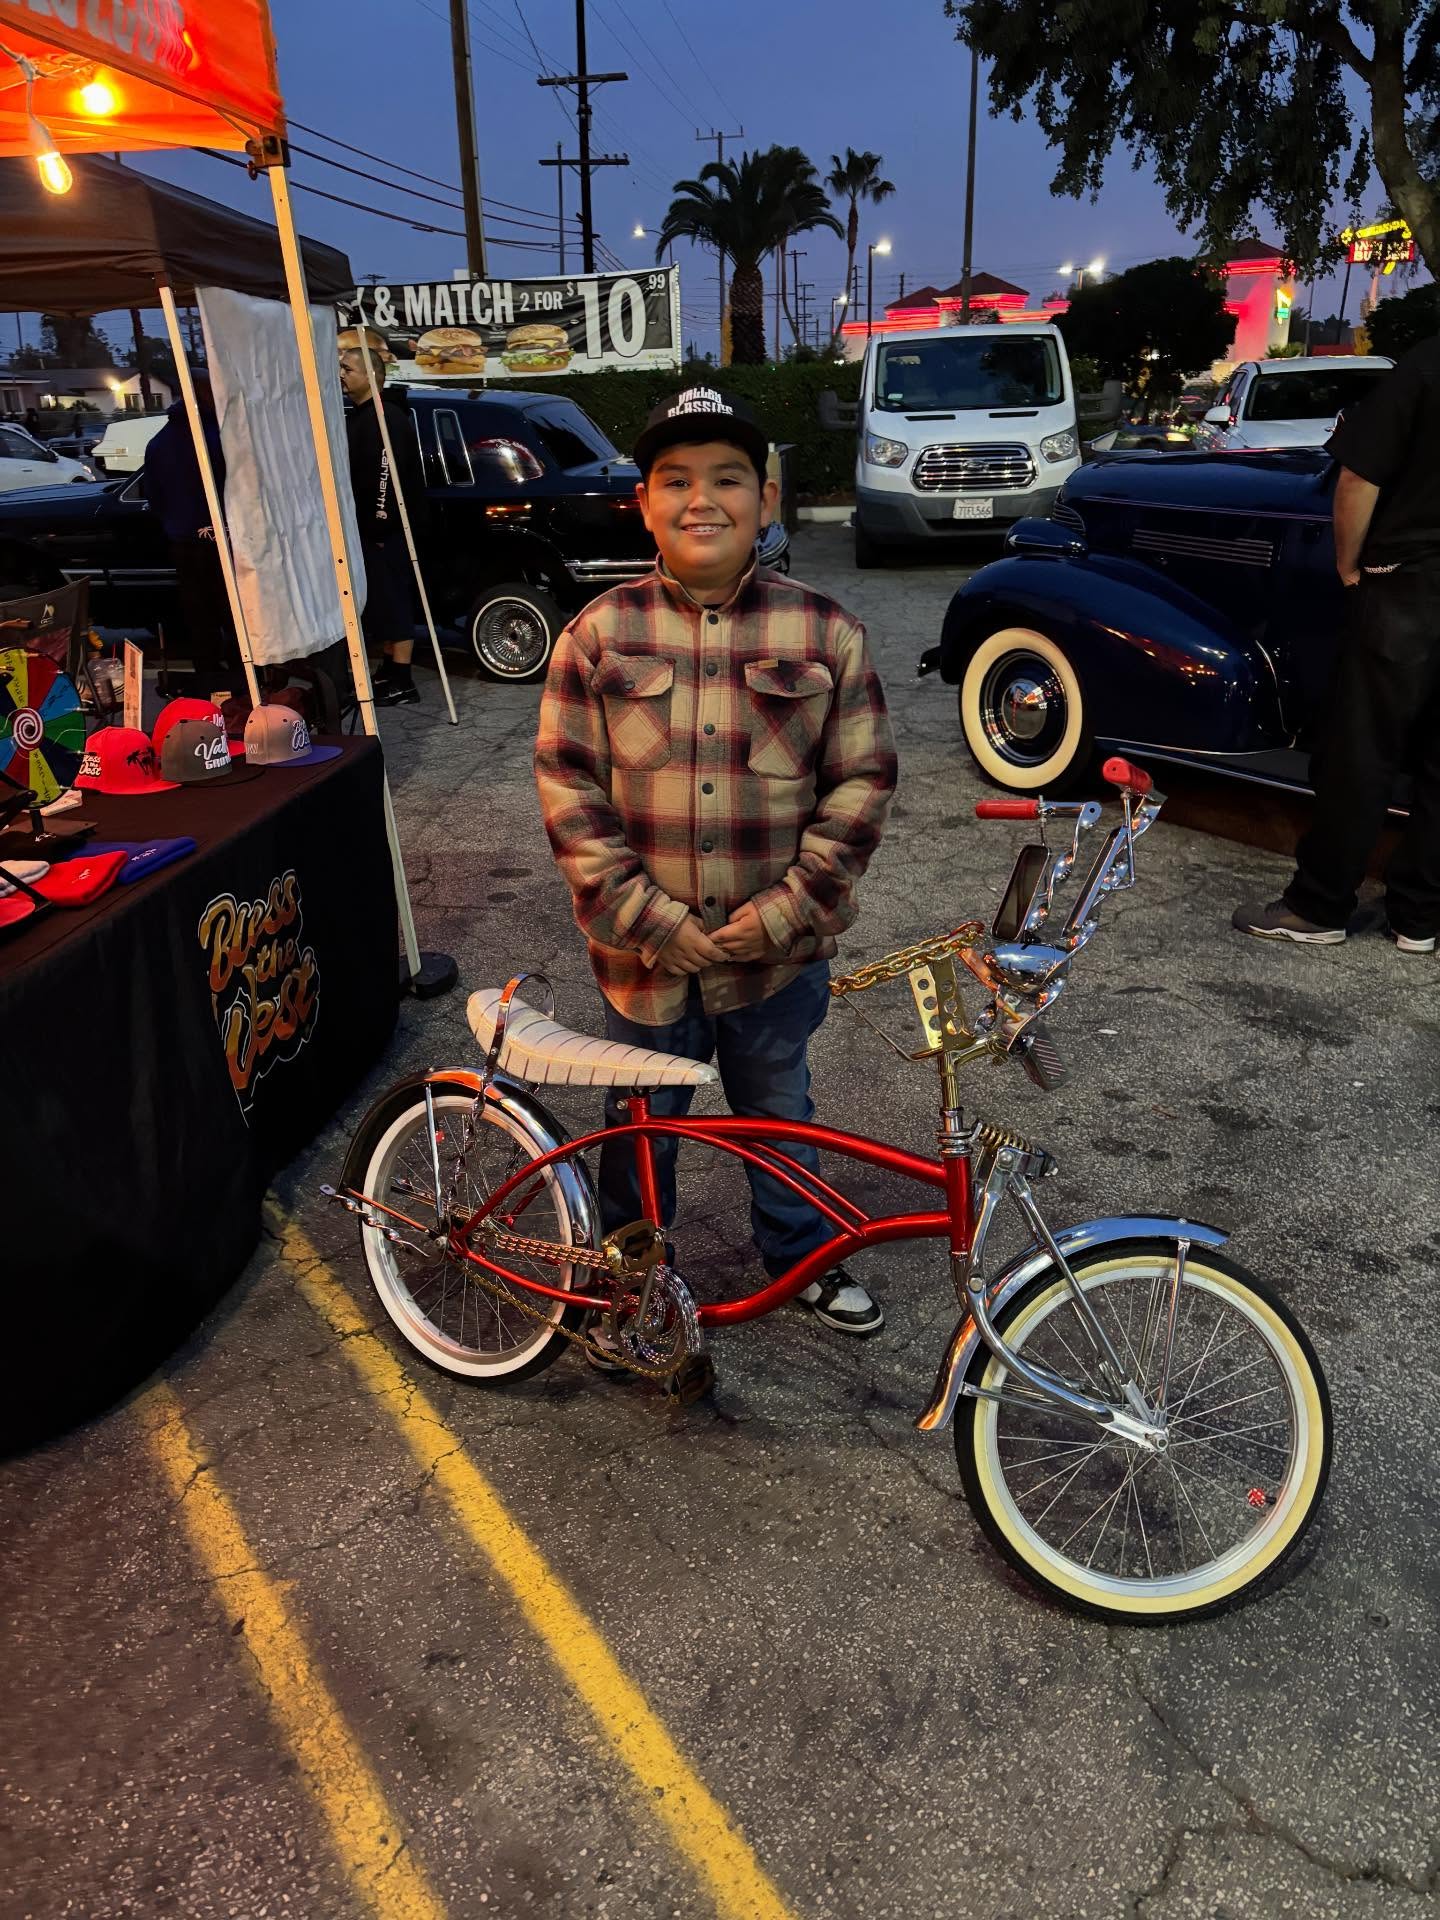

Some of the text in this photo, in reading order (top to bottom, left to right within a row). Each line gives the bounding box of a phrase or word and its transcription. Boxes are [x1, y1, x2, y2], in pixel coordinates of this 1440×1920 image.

[374, 286, 399, 327] &
[403, 282, 514, 327] MATCH
[520, 292, 530, 311] 2
[534, 291, 563, 311] FOR
[667, 400, 733, 418] CLASSICS
[678, 387, 722, 406] VALLEY
[194, 734, 228, 760] Vall
[198, 869, 300, 993] Bless
[256, 939, 296, 983] the
